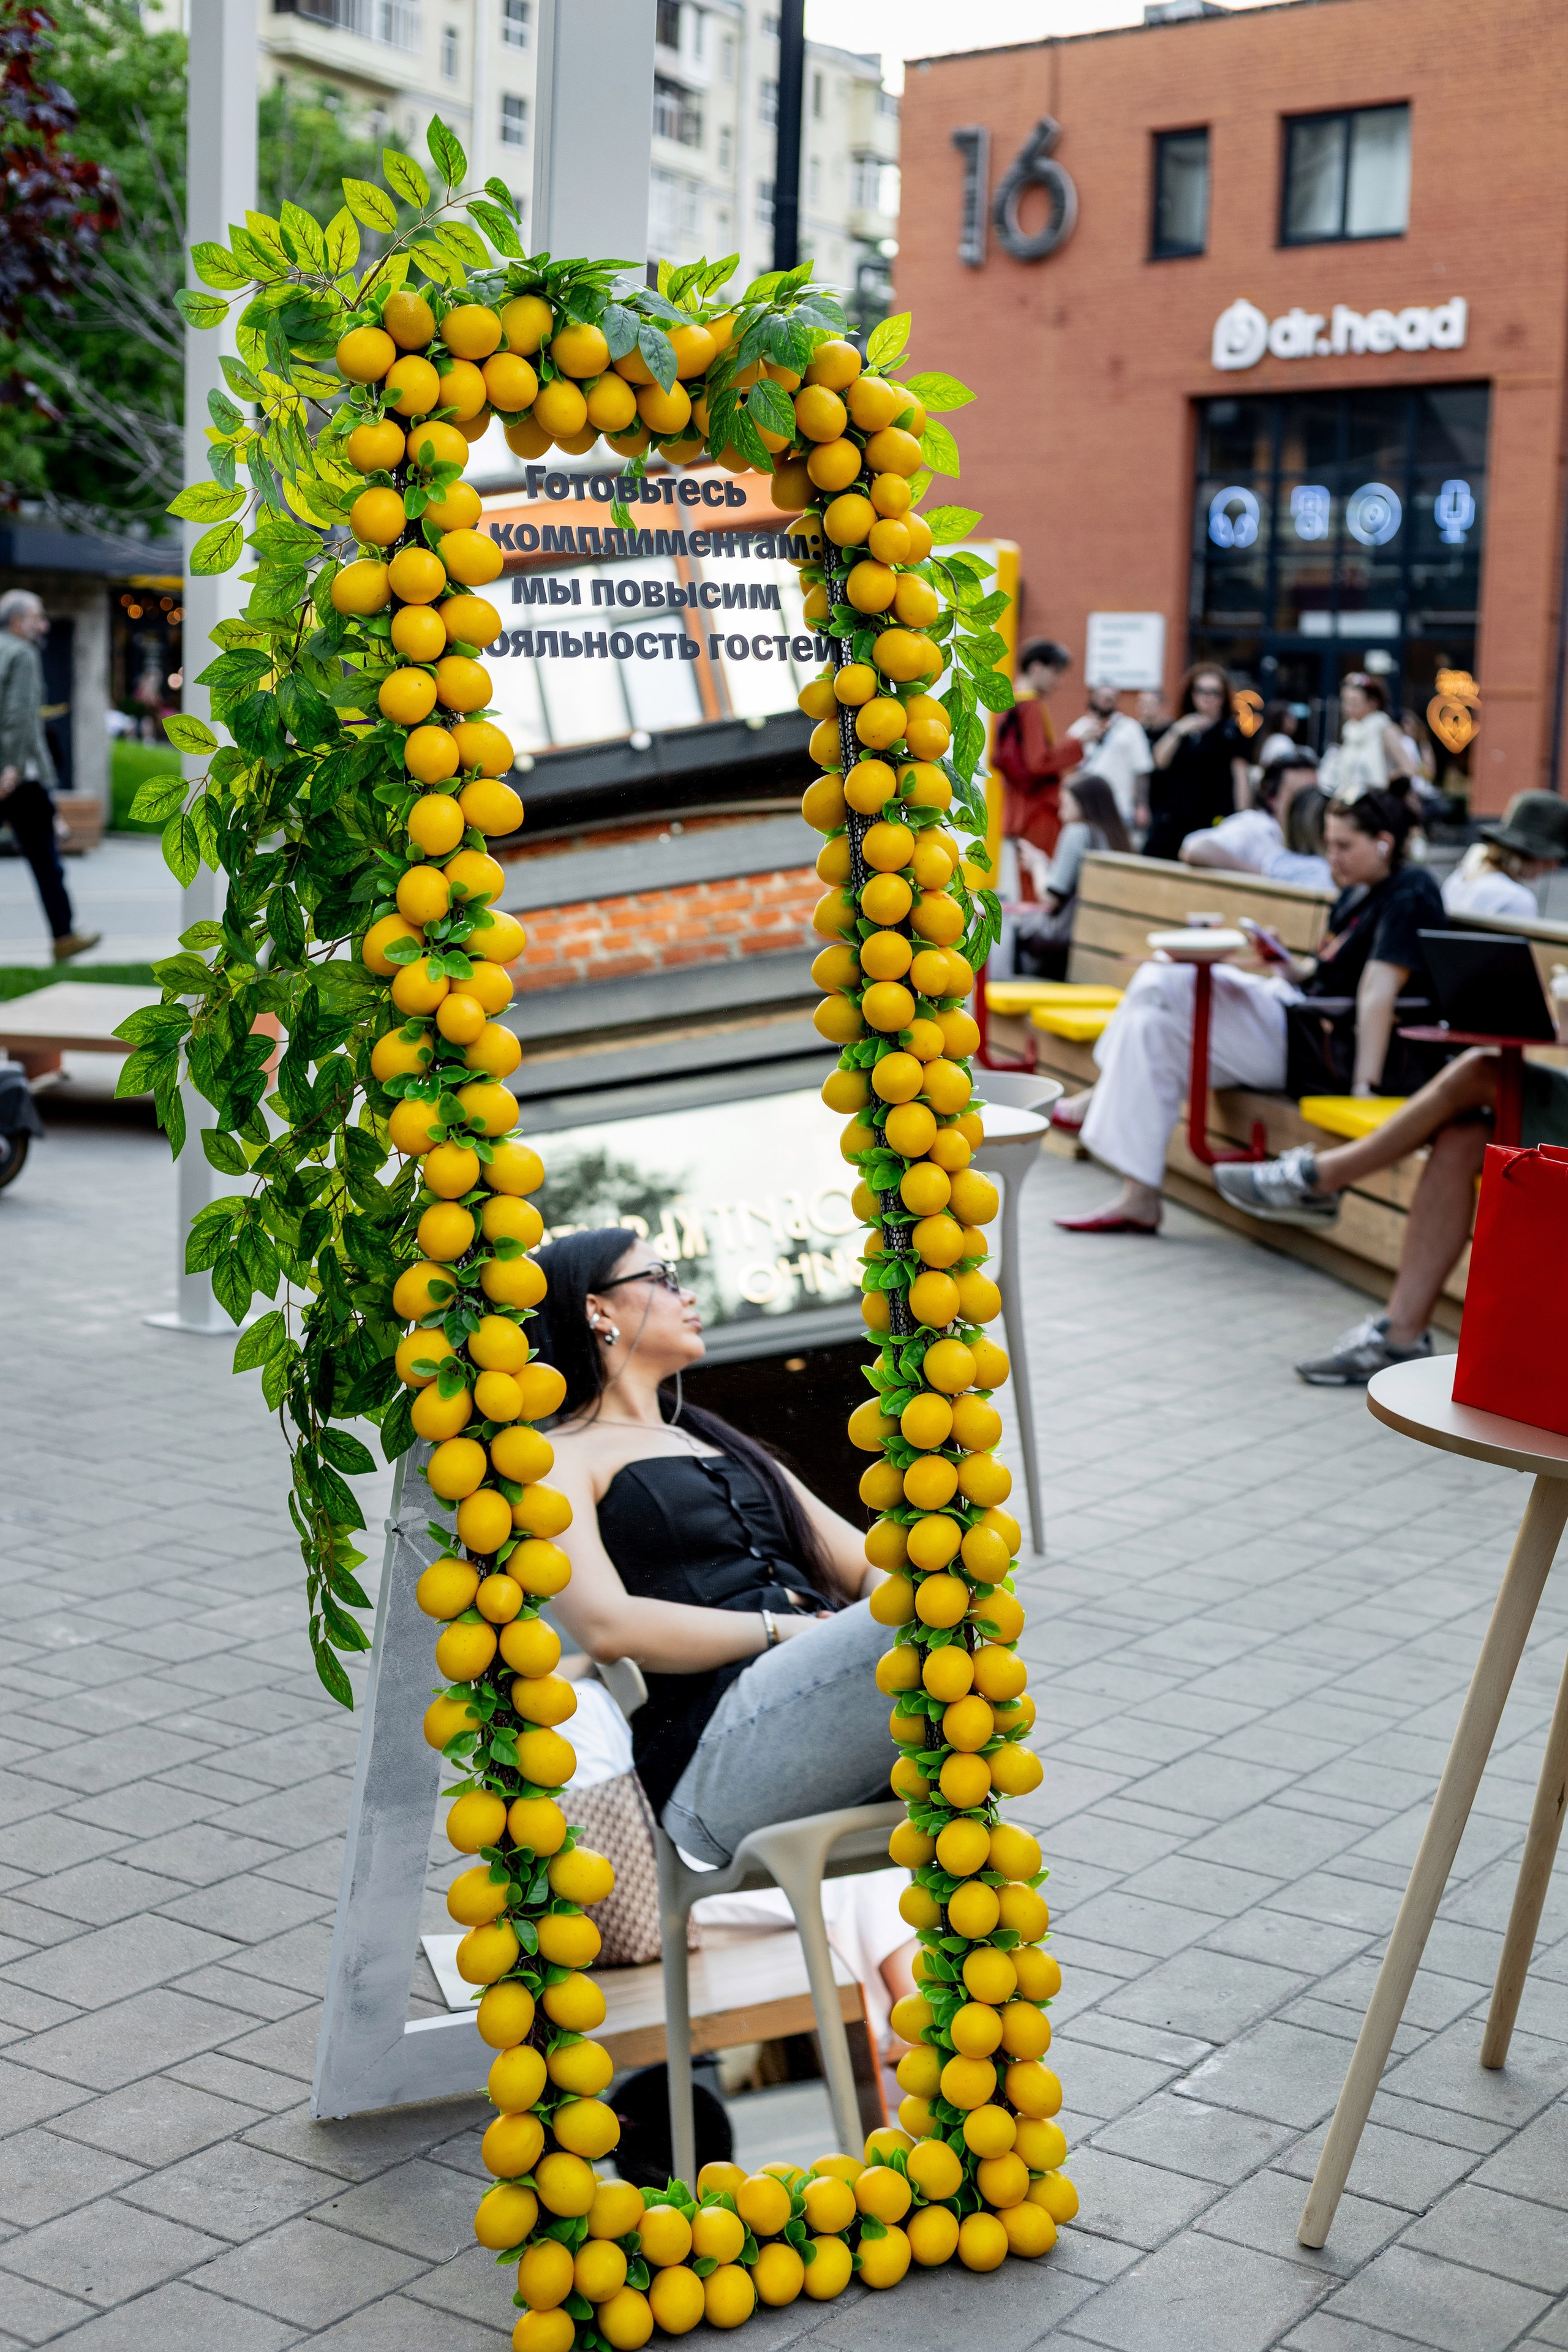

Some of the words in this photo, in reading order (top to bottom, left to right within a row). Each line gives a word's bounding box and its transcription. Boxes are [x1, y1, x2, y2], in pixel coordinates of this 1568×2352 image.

[950, 114, 1079, 270] 16
[1269, 296, 1468, 359] dr.head
[525, 464, 747, 508] Готовьтесь
[491, 522, 823, 561] комплиментам:
[511, 576, 581, 605] мы
[591, 578, 782, 611] повысим
[480, 630, 700, 660] ояльность
[708, 628, 837, 663] гостей
